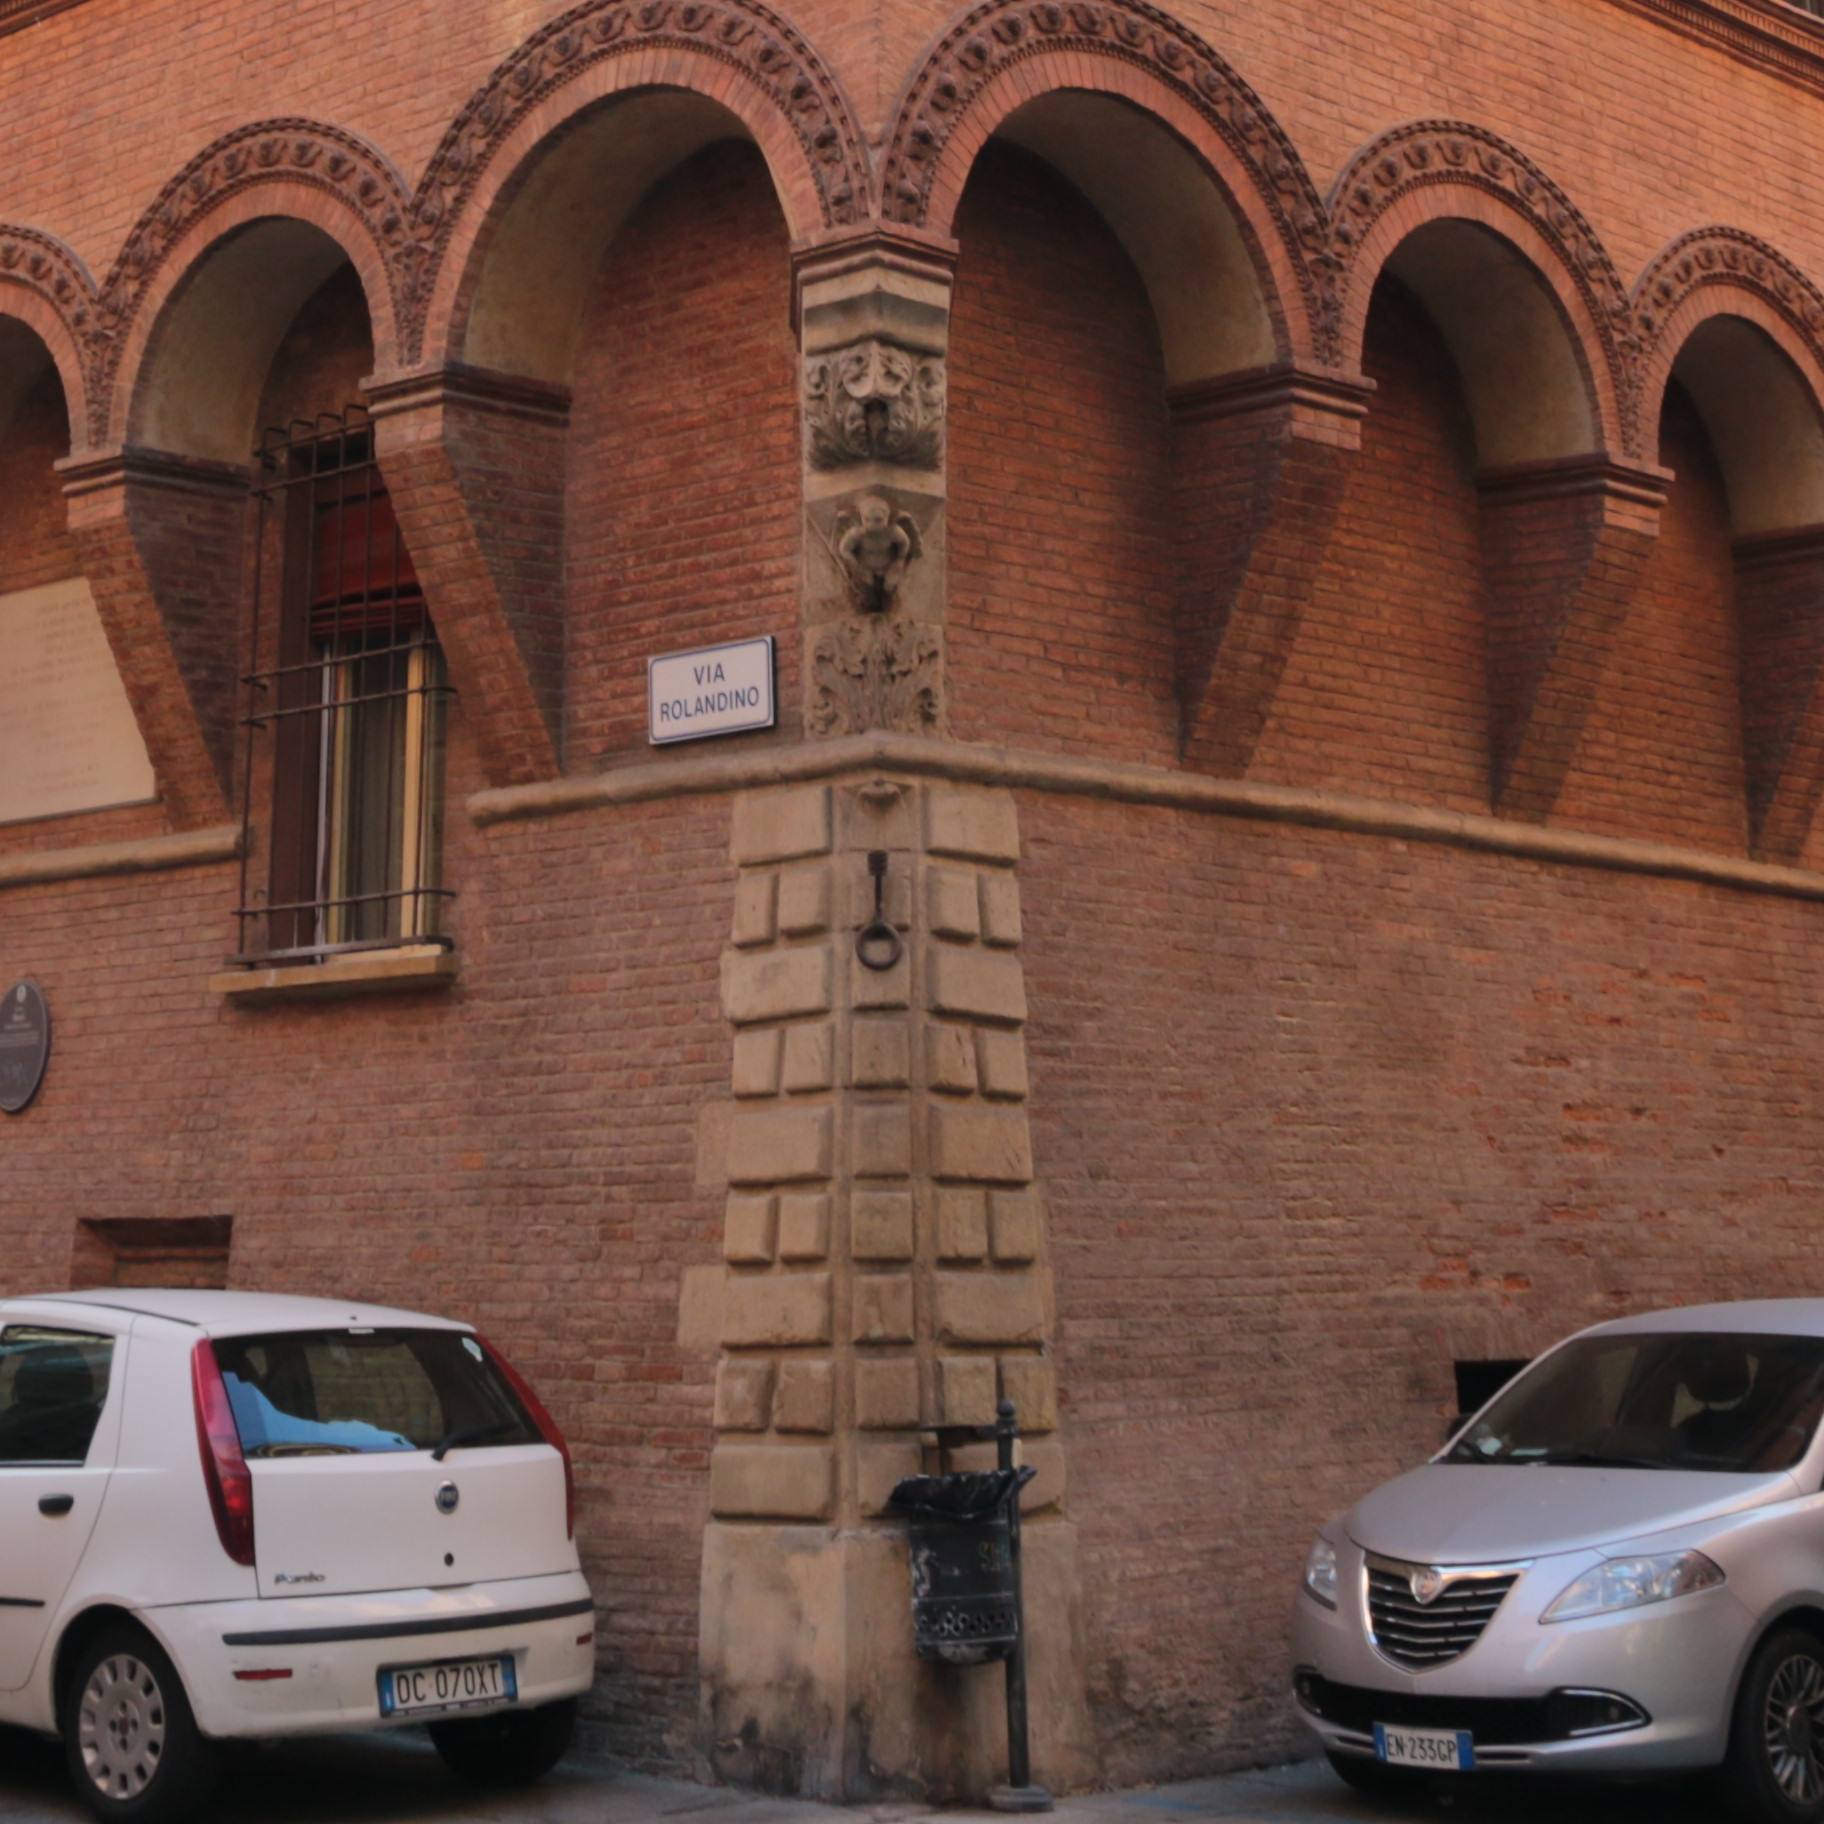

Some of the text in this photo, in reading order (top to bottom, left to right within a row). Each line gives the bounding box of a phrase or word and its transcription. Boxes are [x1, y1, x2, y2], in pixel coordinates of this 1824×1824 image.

[693, 662, 726, 686] VIA
[660, 686, 760, 723] ROLANDINO
[396, 1662, 498, 1704] DC 070XT
[1387, 1734, 1457, 1763] EN 233GP
